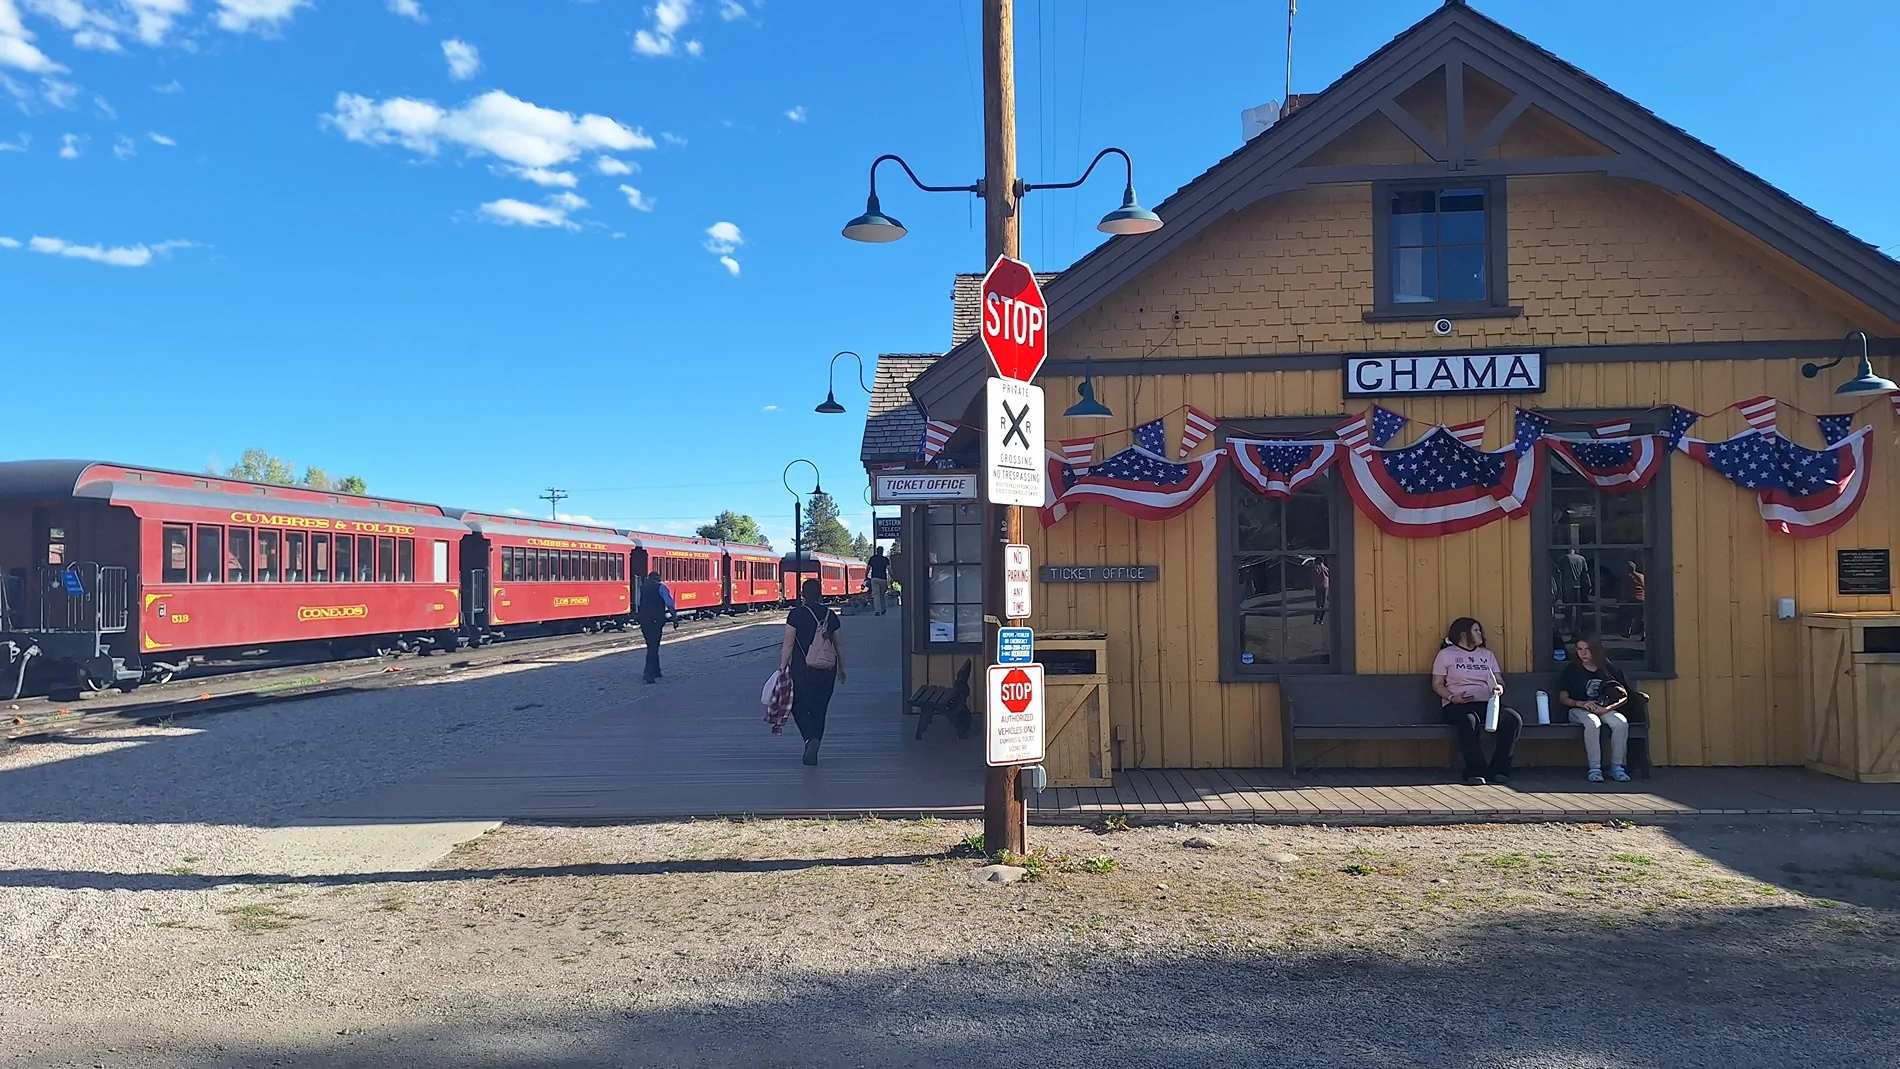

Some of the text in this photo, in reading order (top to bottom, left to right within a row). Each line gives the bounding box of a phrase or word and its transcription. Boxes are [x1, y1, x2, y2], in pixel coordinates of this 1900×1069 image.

[986, 291, 1042, 347] STOP
[1356, 355, 1536, 391] CHAMA
[1002, 384, 1029, 397] PRIVATE
[1001, 416, 1006, 429] R
[1026, 420, 1031, 433] R
[1000, 453, 1032, 466] CROSSING
[993, 469, 1040, 482] NO TRESPASSING
[886, 479, 966, 490] TICKET OFFICE
[230, 512, 416, 535] CUMBRES & TOLTEC
[527, 538, 569, 548] CUMBRES
[578, 542, 608, 550] TOLTEC
[1013, 551, 1023, 564] NO
[1008, 569, 1028, 582] PARKING
[1050, 567, 1145, 580] TICKET OFFICE
[1013, 587, 1023, 597] ANY
[303, 606, 363, 618] CONEJOS
[1013, 601, 1024, 611] TIME
[1002, 682, 1031, 701] STOP
[1001, 713, 1034, 723] AUTHORIZED
[997, 725, 1037, 736] VEHICLES ONLY
